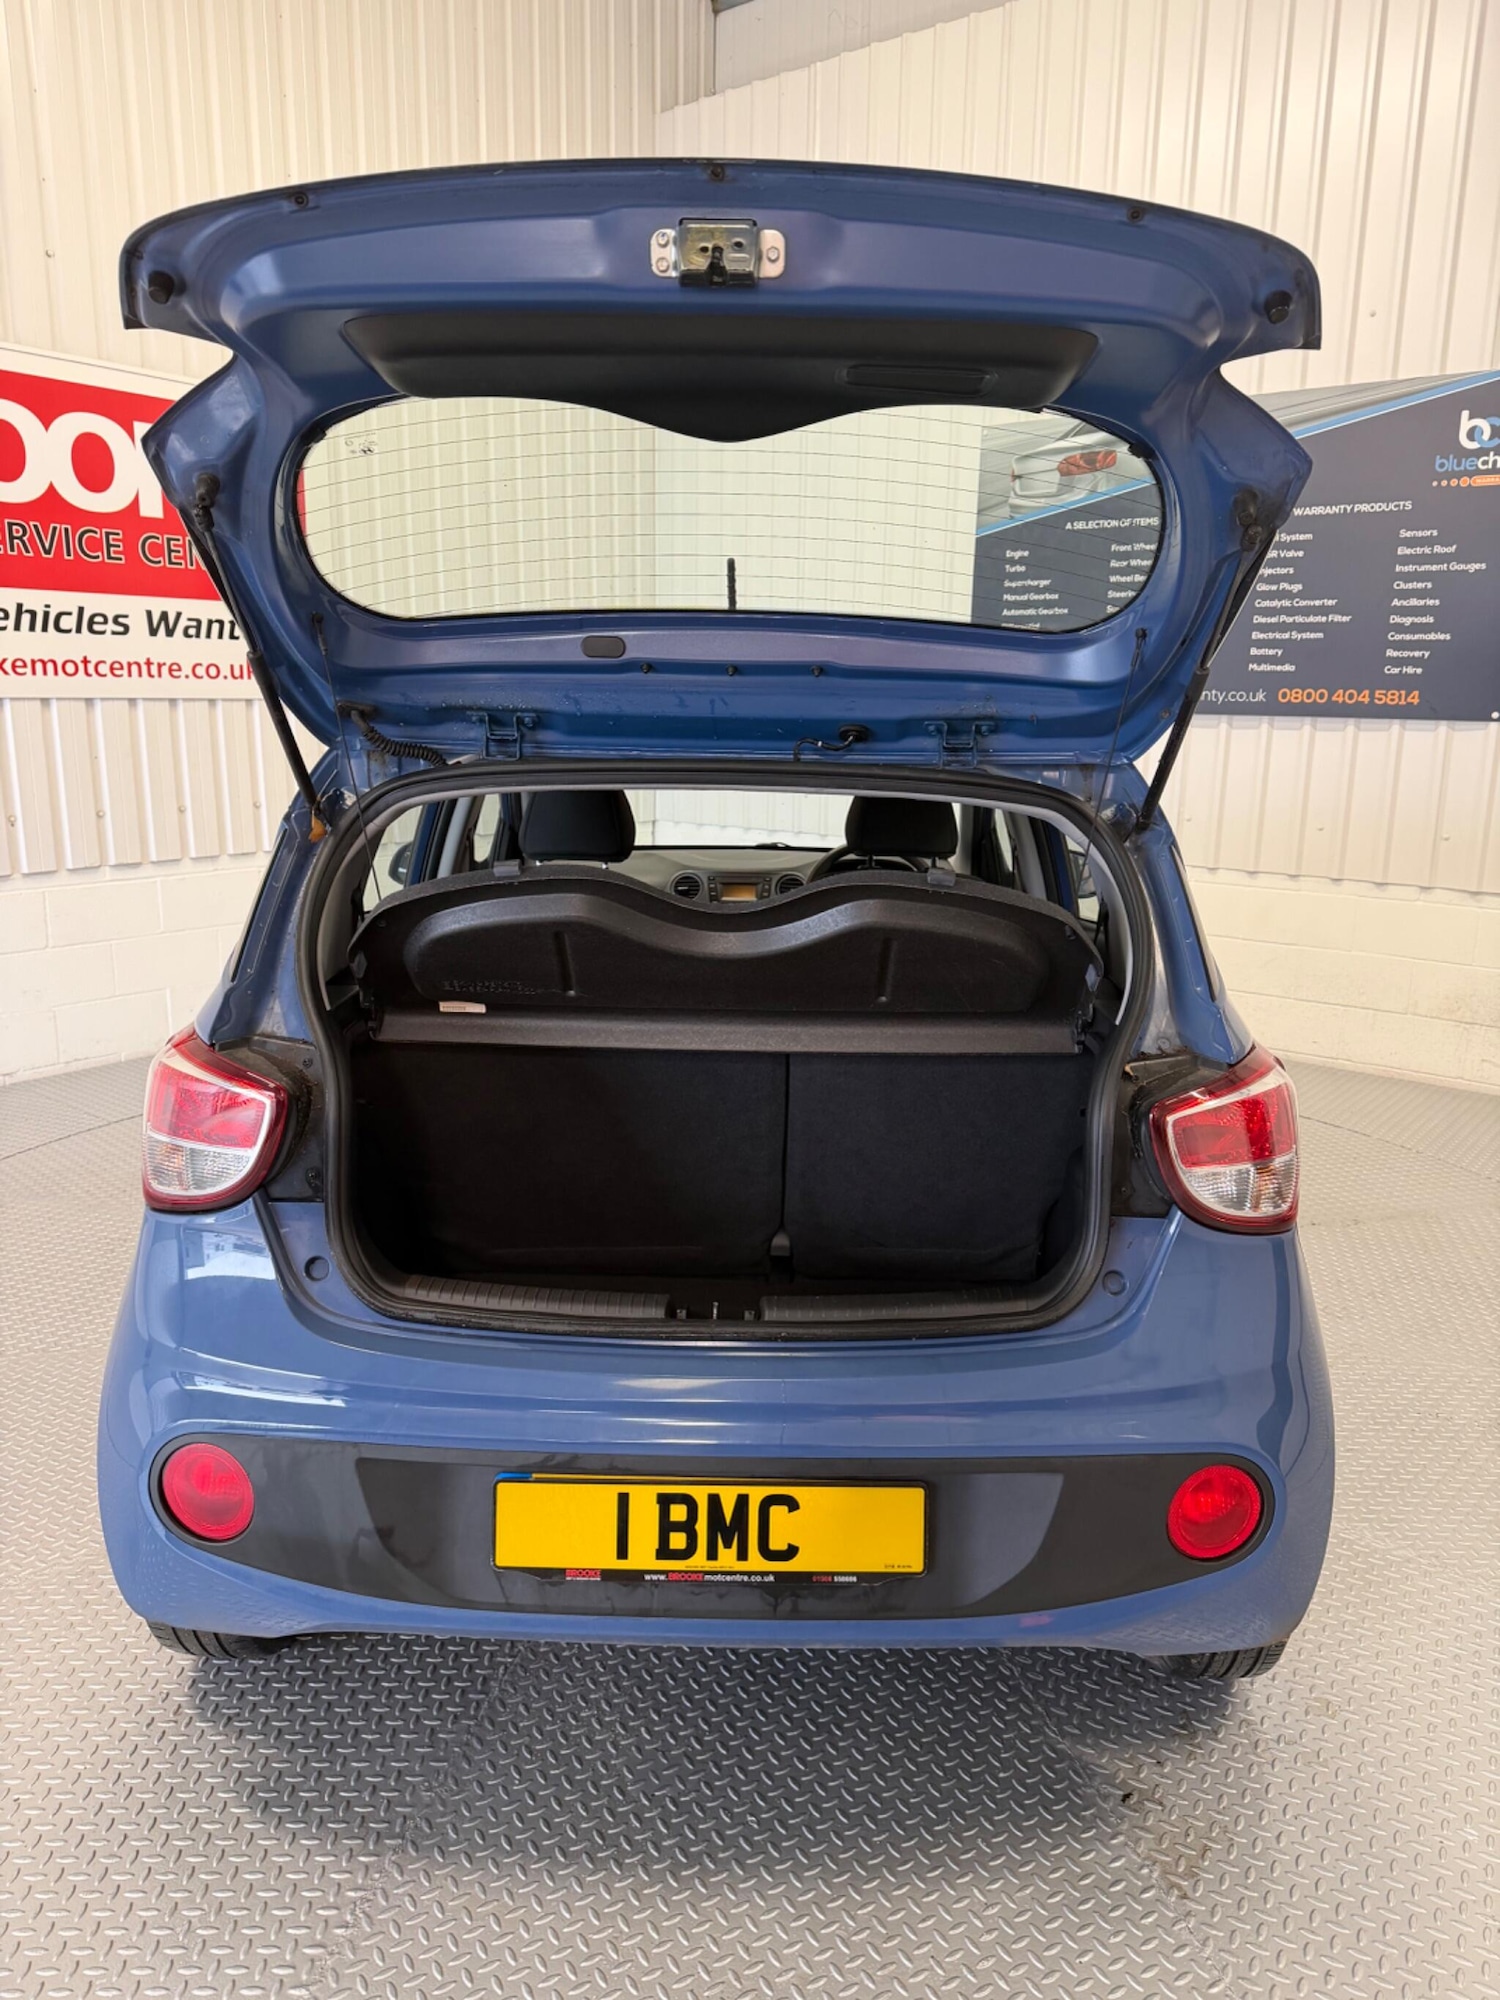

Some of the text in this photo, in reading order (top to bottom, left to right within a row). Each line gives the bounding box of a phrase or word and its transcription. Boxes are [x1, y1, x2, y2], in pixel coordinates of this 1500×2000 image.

[1293, 501, 1412, 516] WARRANTY PRODUCTS
[1073, 519, 1118, 529] SELECTION
[1132, 517, 1159, 526] ITEMS
[1280, 533, 1313, 542] System
[1399, 529, 1438, 538] Sensors
[1006, 550, 1029, 559] Engine
[1279, 550, 1304, 558] Valve
[1397, 544, 1457, 555] Electric Roof
[1395, 562, 1486, 573] Instrument Gauges
[1109, 575, 1133, 583] Wheel
[1256, 582, 1303, 593] Glow Plugs
[1393, 580, 1432, 590] Clusters
[1003, 592, 1059, 601] Manual Gearbox
[1254, 598, 1337, 608] Catalytic Converter
[1391, 598, 1440, 607] Ancillaries
[1002, 608, 1037, 616] Automatic
[1253, 614, 1352, 623] Diesel Particulate Filter
[1389, 614, 1434, 626] Diagnosis
[1251, 630, 1324, 641] Electrical System
[1387, 631, 1451, 641] Consumables
[1250, 647, 1283, 657] Battery
[1385, 648, 1430, 659] Recovery
[1248, 663, 1296, 672] Multimedia
[1384, 665, 1423, 674] Car Hire
[1277, 688, 1328, 703] 0800
[1331, 689, 1370, 704] 404
[1373, 690, 1420, 705] 5814
[655, 1492, 799, 1562] BMC
